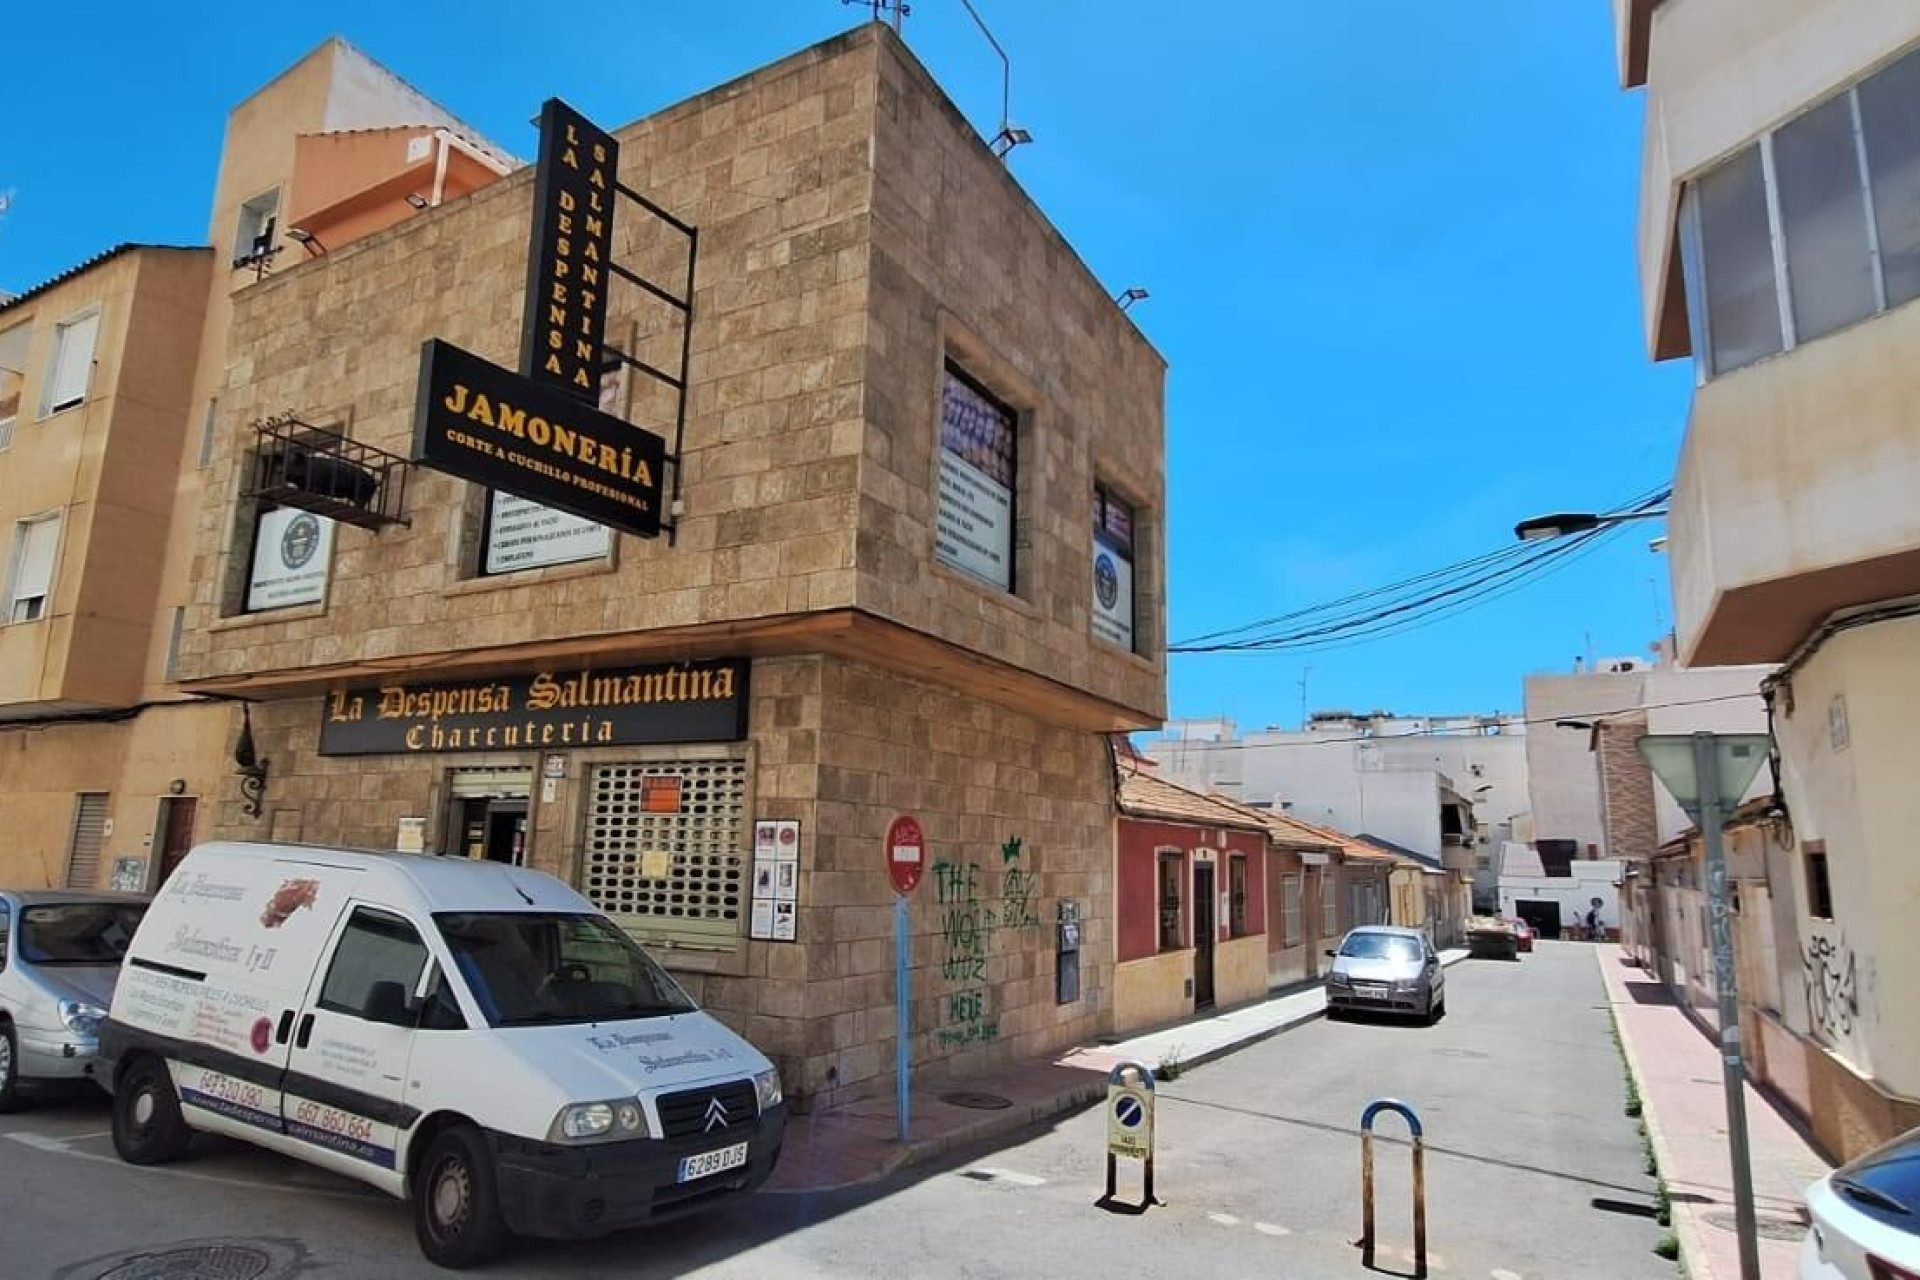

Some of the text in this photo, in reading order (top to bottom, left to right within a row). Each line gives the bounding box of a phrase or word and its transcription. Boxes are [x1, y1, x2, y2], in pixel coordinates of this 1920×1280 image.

[545, 123, 579, 376] LA DESPENSA
[573, 144, 607, 389] SALMANTINA
[445, 383, 653, 487] JAMONERÍA
[446, 428, 650, 512] CORTE A CUCHILLO PROFESIONAL
[328, 660, 736, 723] La Despensa Salmantina
[688, 1152, 720, 1177] 6289
